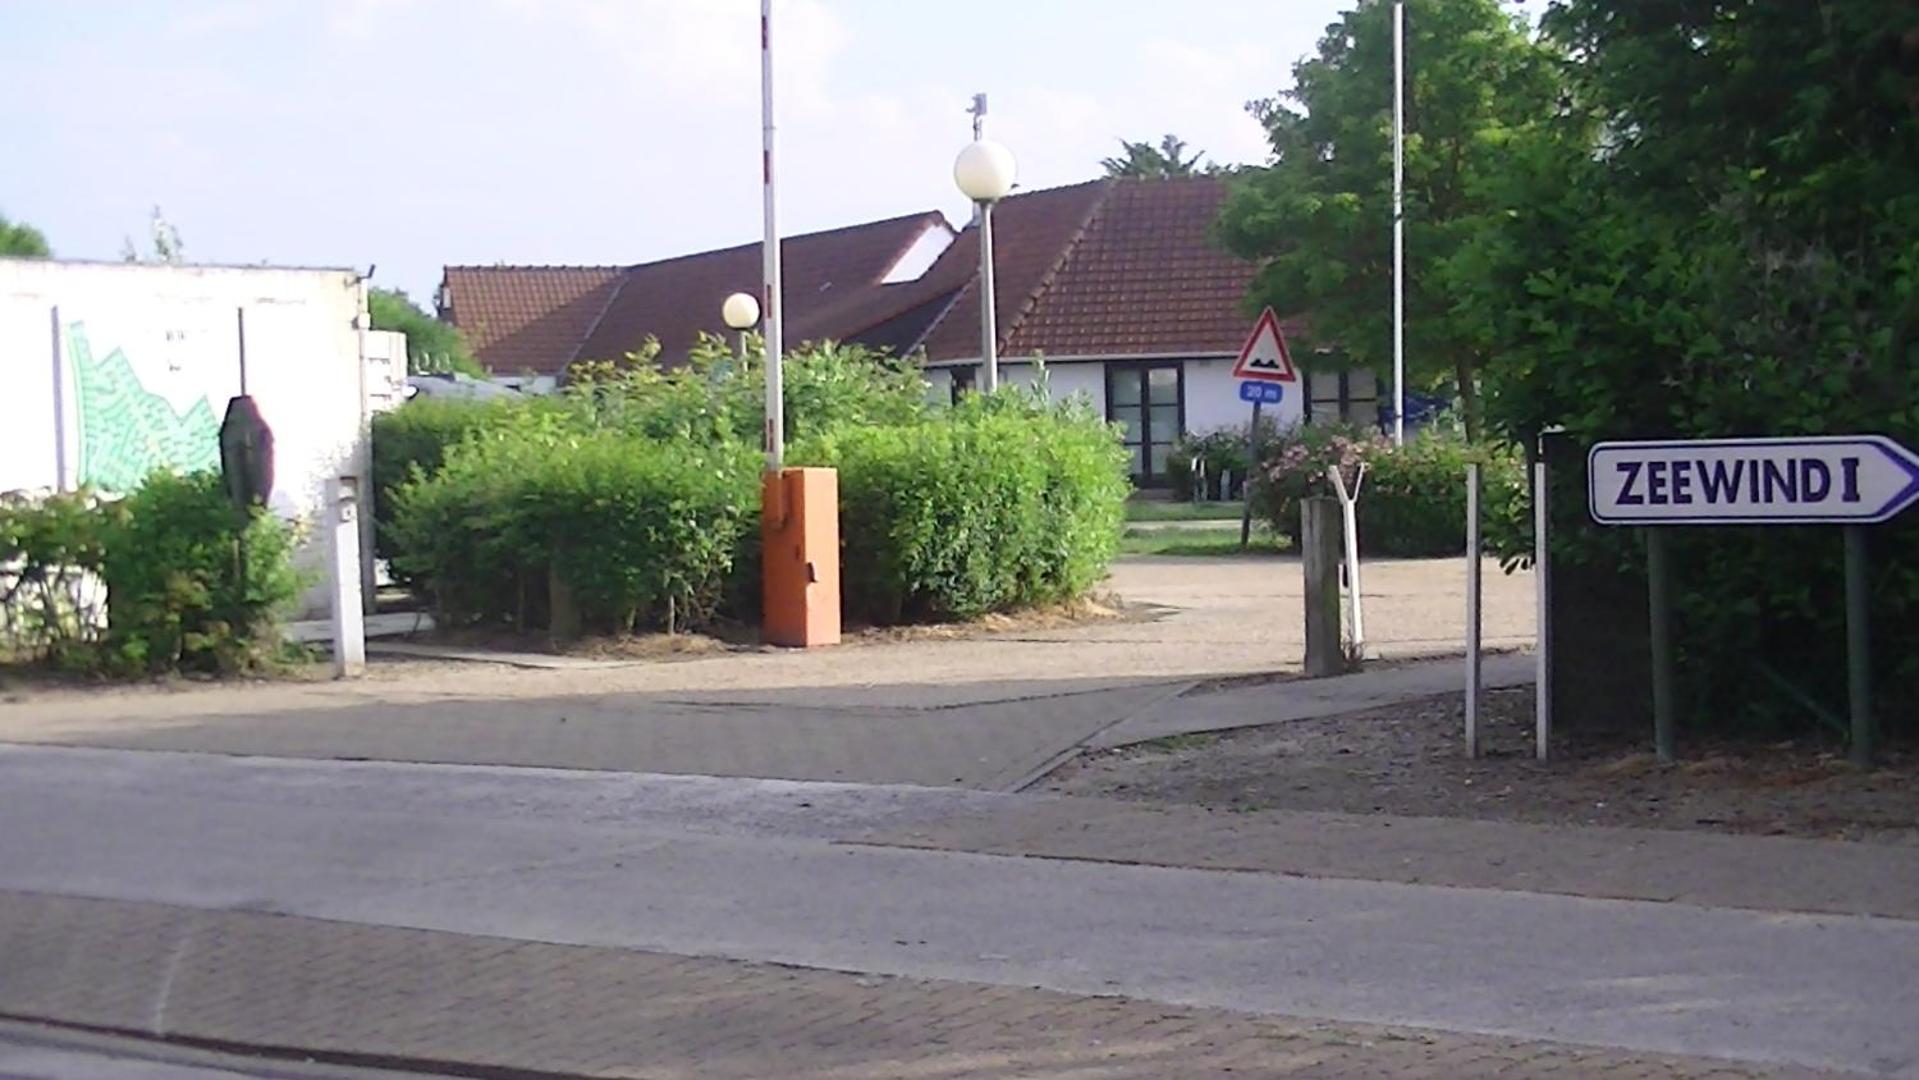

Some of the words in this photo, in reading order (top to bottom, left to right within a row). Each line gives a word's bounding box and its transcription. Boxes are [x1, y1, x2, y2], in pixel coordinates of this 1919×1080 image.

[1264, 389, 1278, 400] m
[1615, 458, 1831, 505] ZEEWIND
[1841, 457, 1860, 502] I
